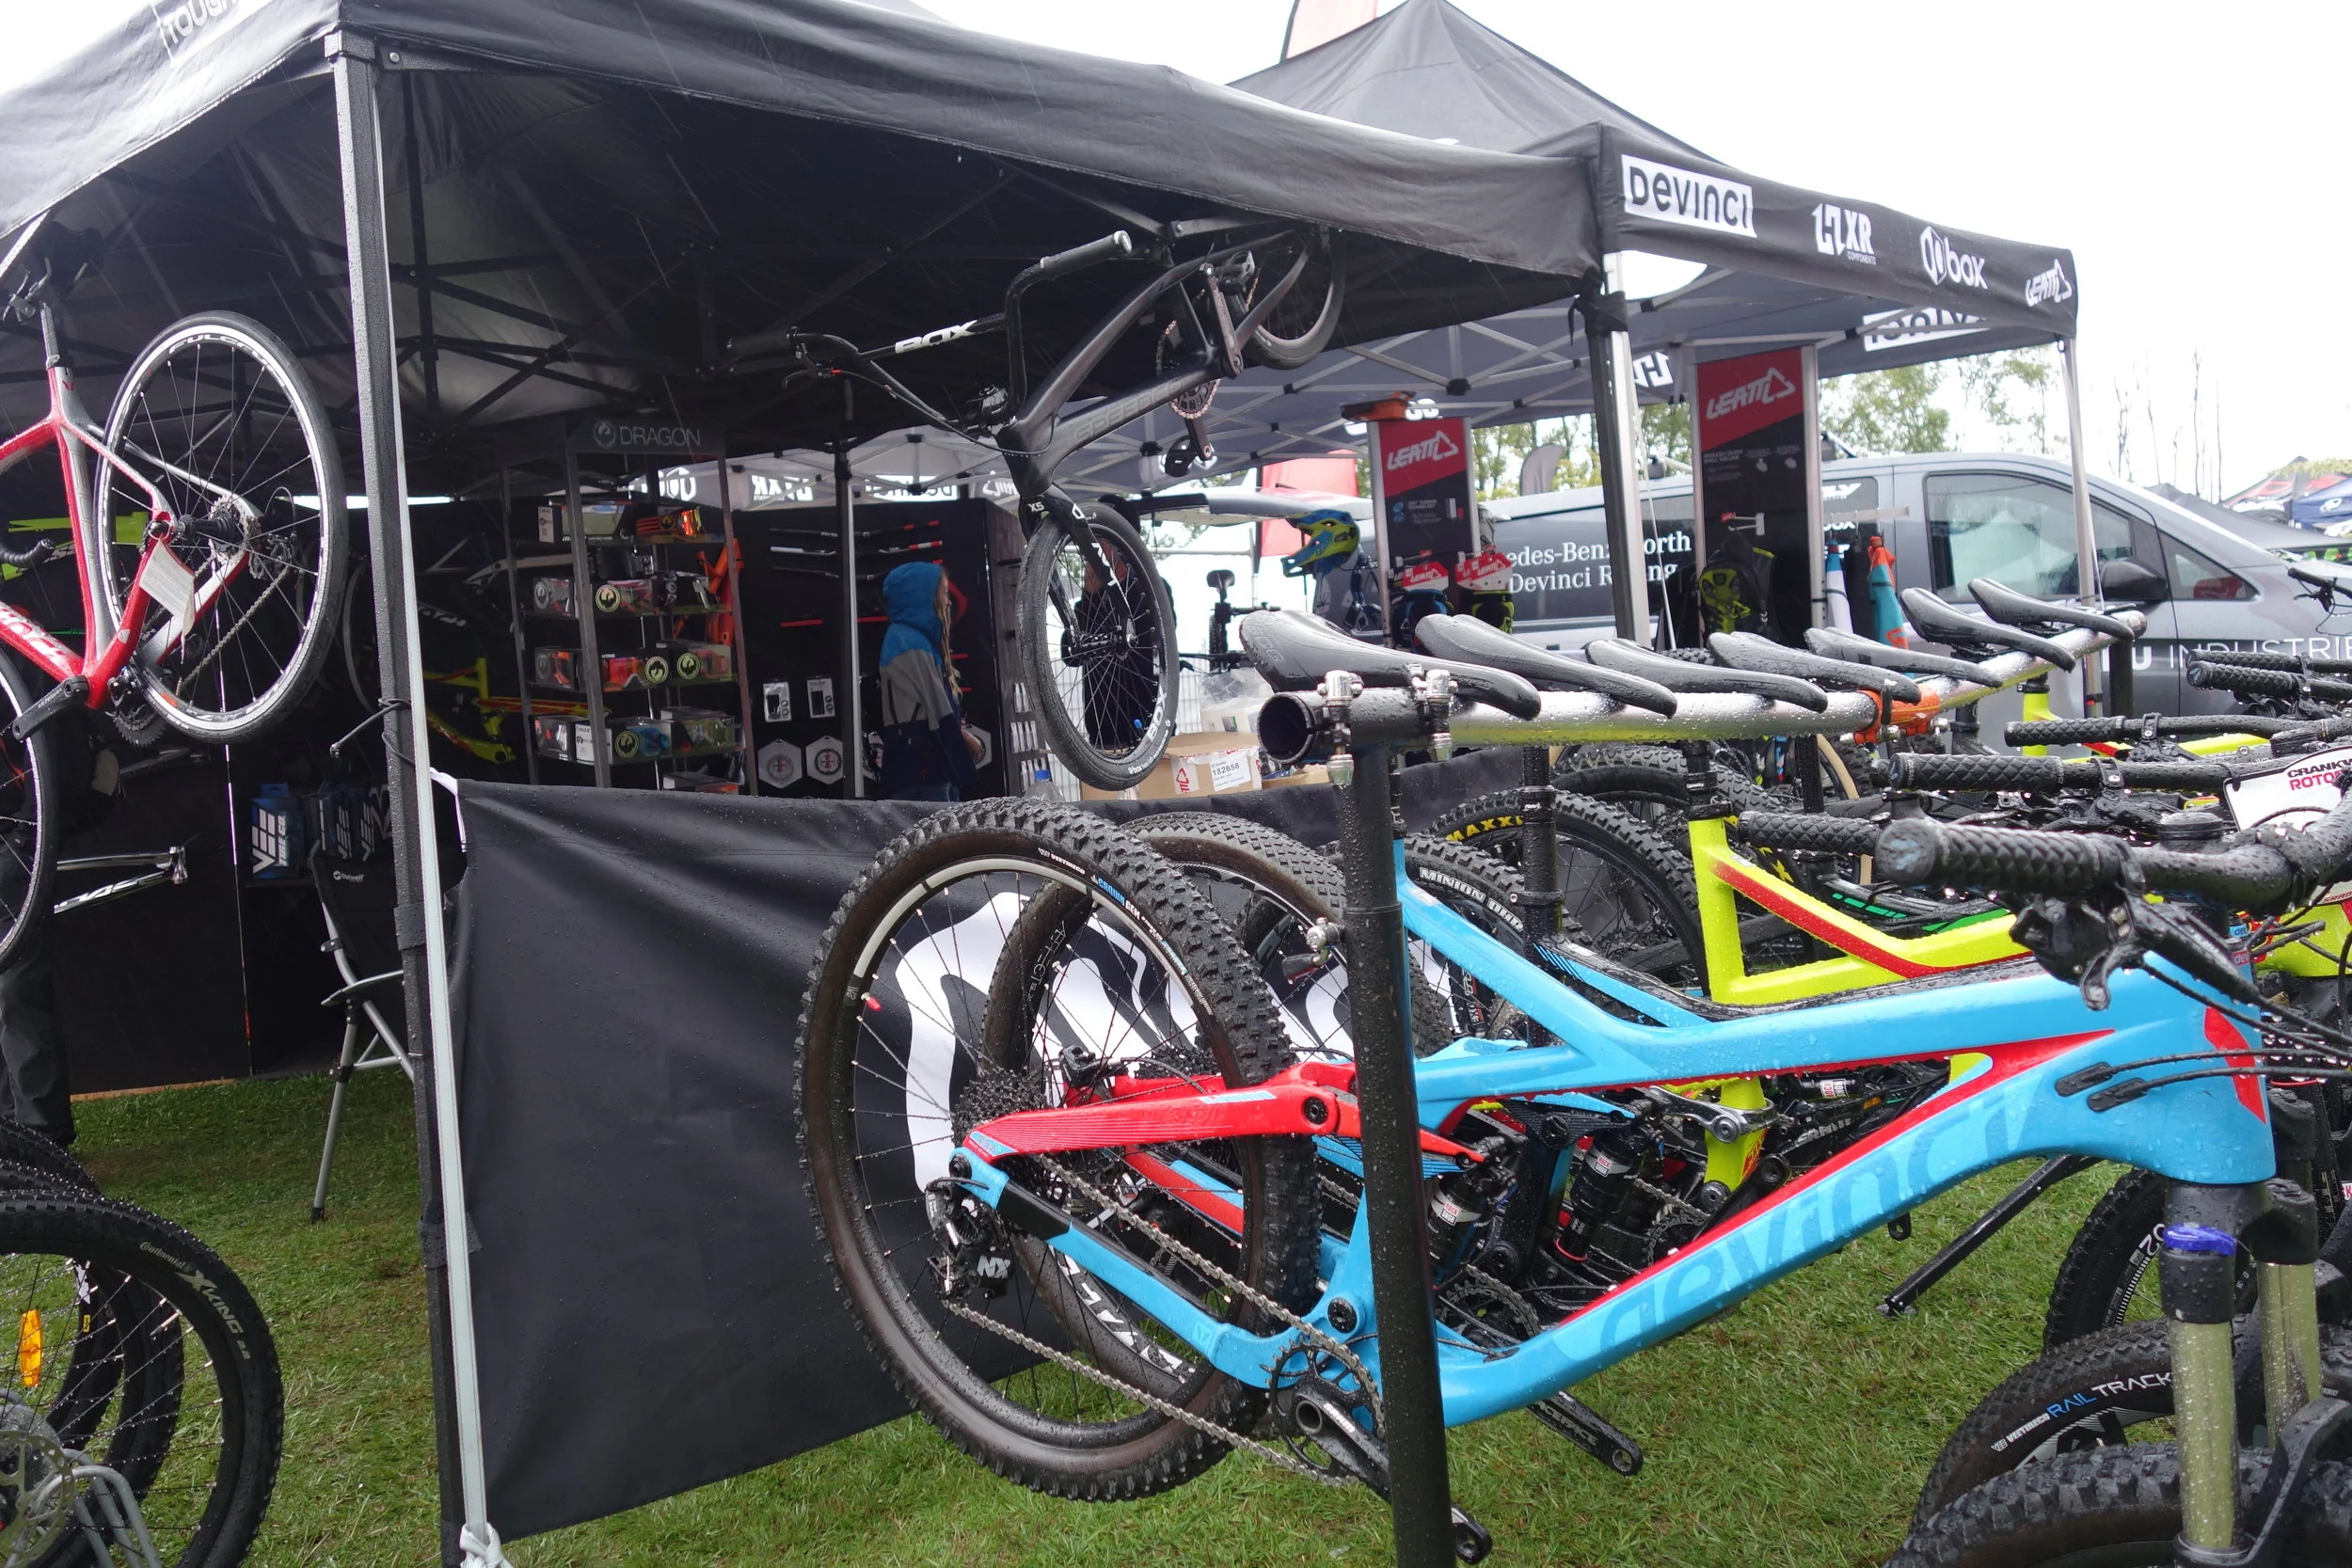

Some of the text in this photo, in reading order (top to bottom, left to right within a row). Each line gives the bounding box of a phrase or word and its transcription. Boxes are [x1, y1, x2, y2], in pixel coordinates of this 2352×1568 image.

[895, 320, 977, 354] BOX
[620, 425, 702, 448] DRAGON
[1506, 531, 1692, 568] edes-Ben orth
[1509, 568, 1592, 594] Devinci
[1213, 762, 1240, 776] 182858
[1445, 816, 1523, 844] MAXXI
[1419, 866, 1487, 904] MINION
[139, 1241, 186, 1270] Continental
[977, 1255, 1011, 1279] NX
[2046, 1392, 2098, 1418] RAIL
[2091, 1371, 2173, 1398] TRACK
[1538, 1400, 1599, 1447] ACEFACE
